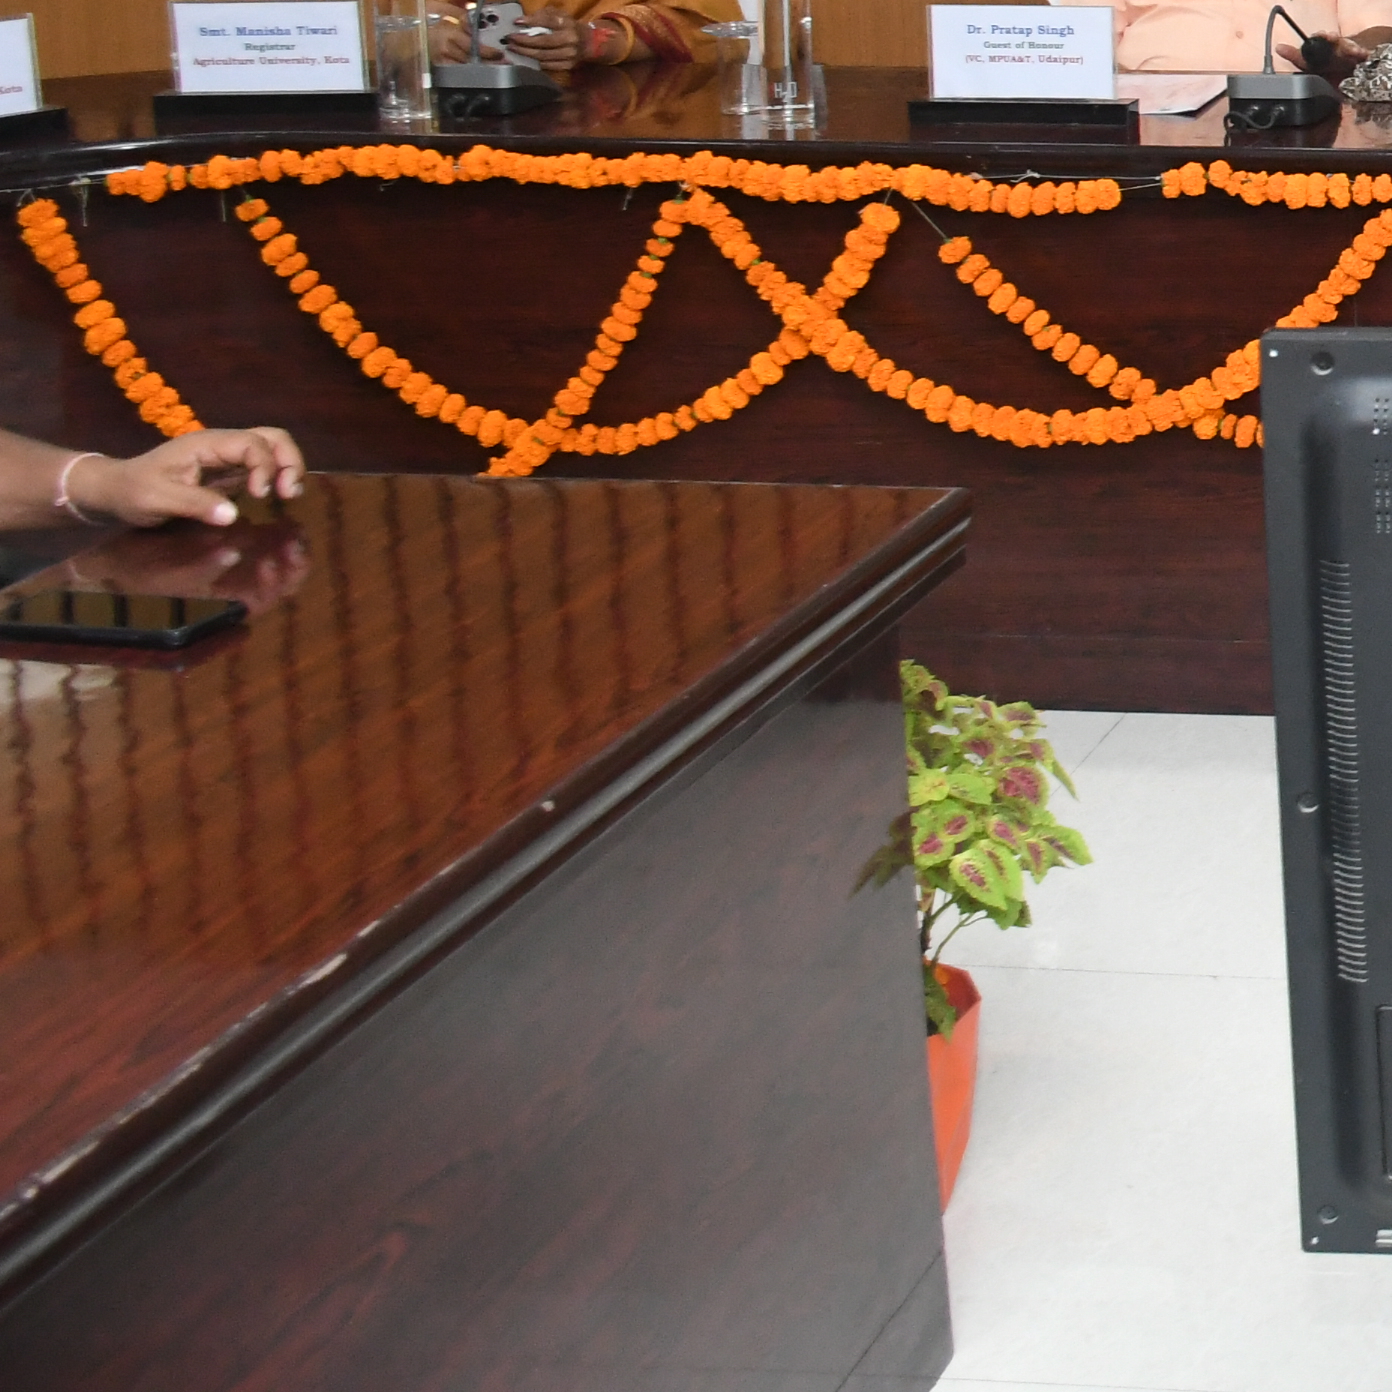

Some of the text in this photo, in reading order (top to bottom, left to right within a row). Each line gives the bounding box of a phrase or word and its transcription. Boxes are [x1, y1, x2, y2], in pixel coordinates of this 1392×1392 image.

[966, 24, 1075, 37] Dr. Pratap Singh
[983, 40, 1065, 50] Guest of Honour
[1038, 54, 1084, 65] Udaipur)
